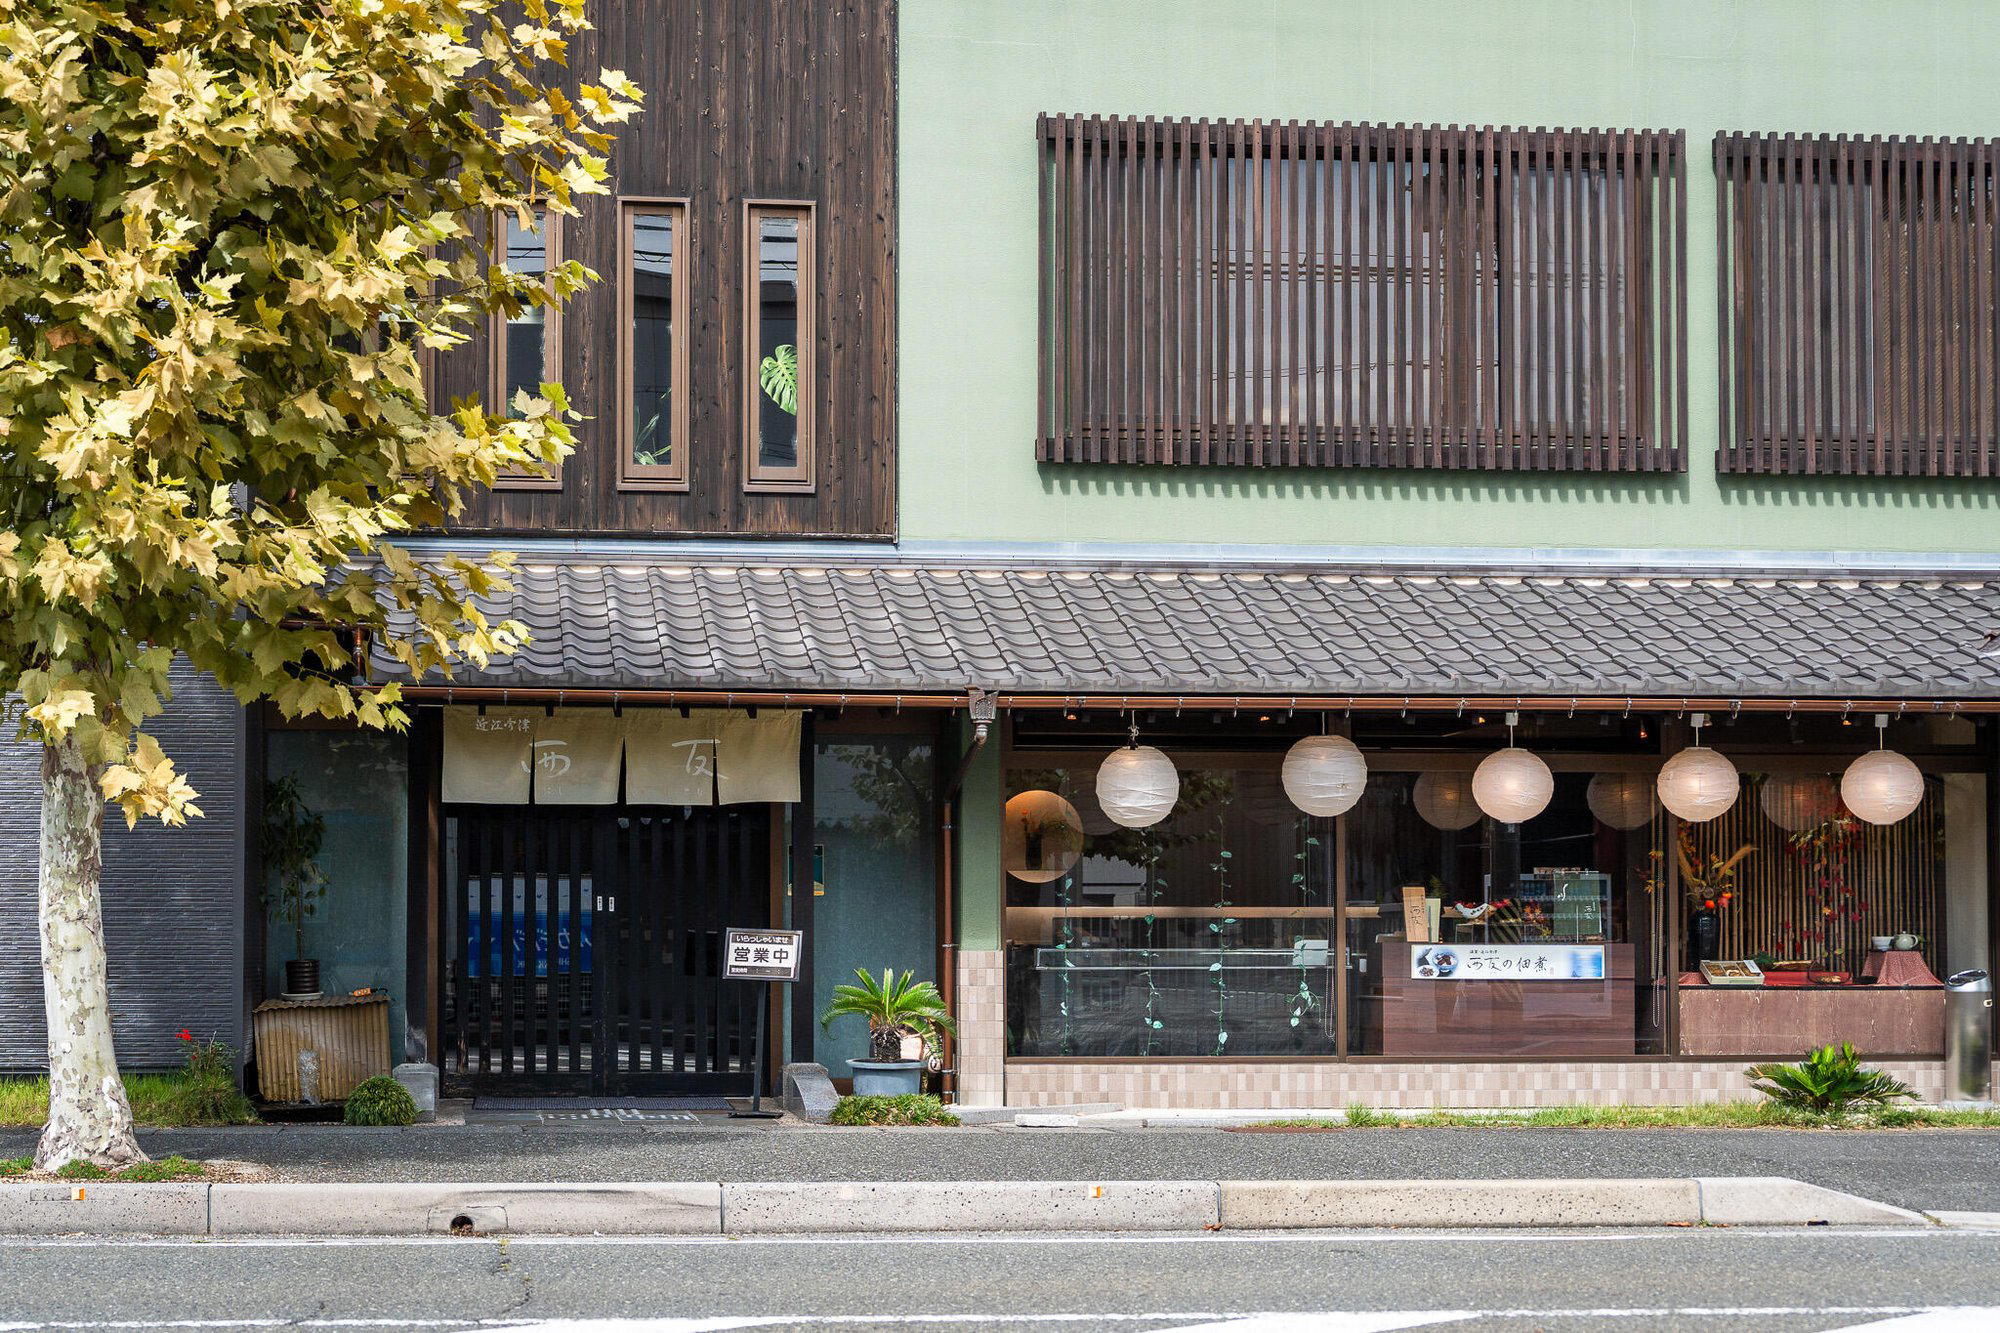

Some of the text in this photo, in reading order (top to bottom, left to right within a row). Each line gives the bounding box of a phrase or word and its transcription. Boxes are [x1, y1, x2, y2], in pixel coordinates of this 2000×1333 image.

[476, 718, 531, 732] 近江今津
[736, 935, 789, 944] いらっしゃいませ
[734, 946, 789, 964] 営業中
